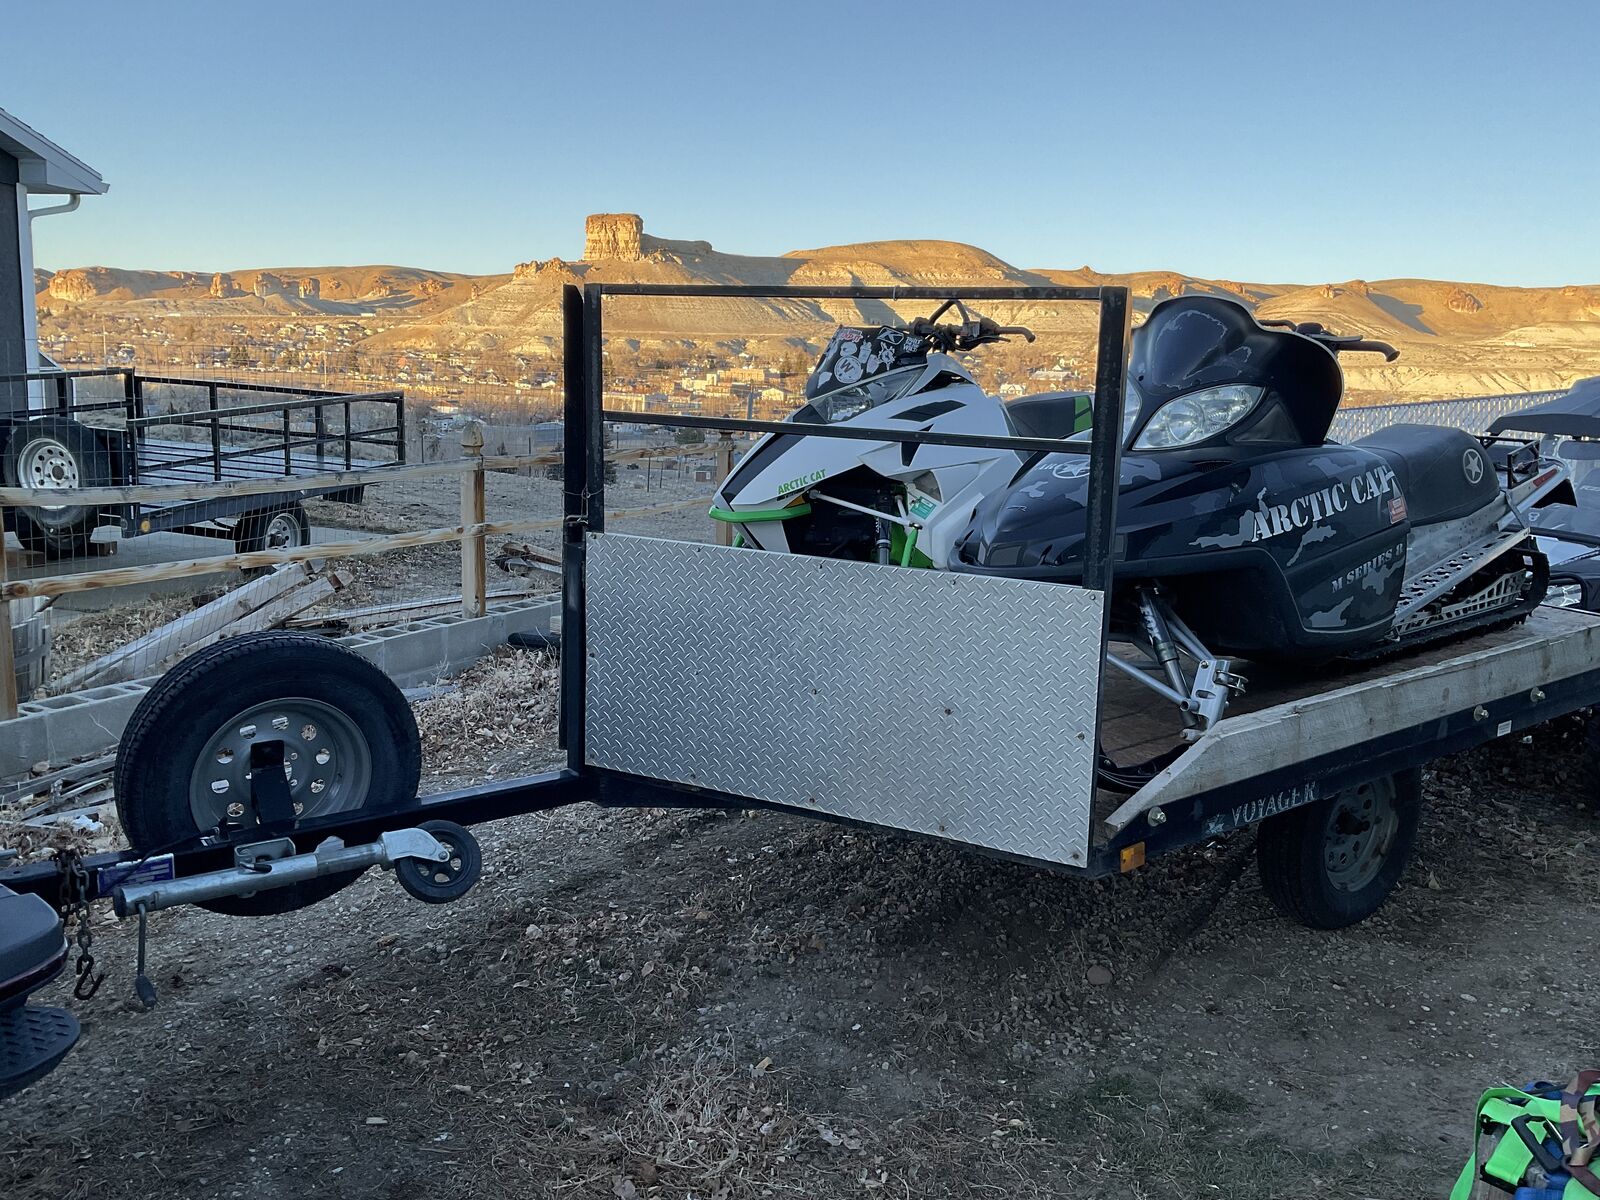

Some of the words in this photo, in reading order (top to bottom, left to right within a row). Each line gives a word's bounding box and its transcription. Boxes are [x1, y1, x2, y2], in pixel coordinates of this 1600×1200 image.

[778, 475, 809, 495] ARCTIC
[810, 469, 826, 482] CAT
[1251, 482, 1348, 543] ARCTIC
[1350, 465, 1395, 504] CAT
[1331, 576, 1343, 593] M
[1346, 548, 1393, 585] SERIES
[1231, 780, 1317, 826] VOYAGER
